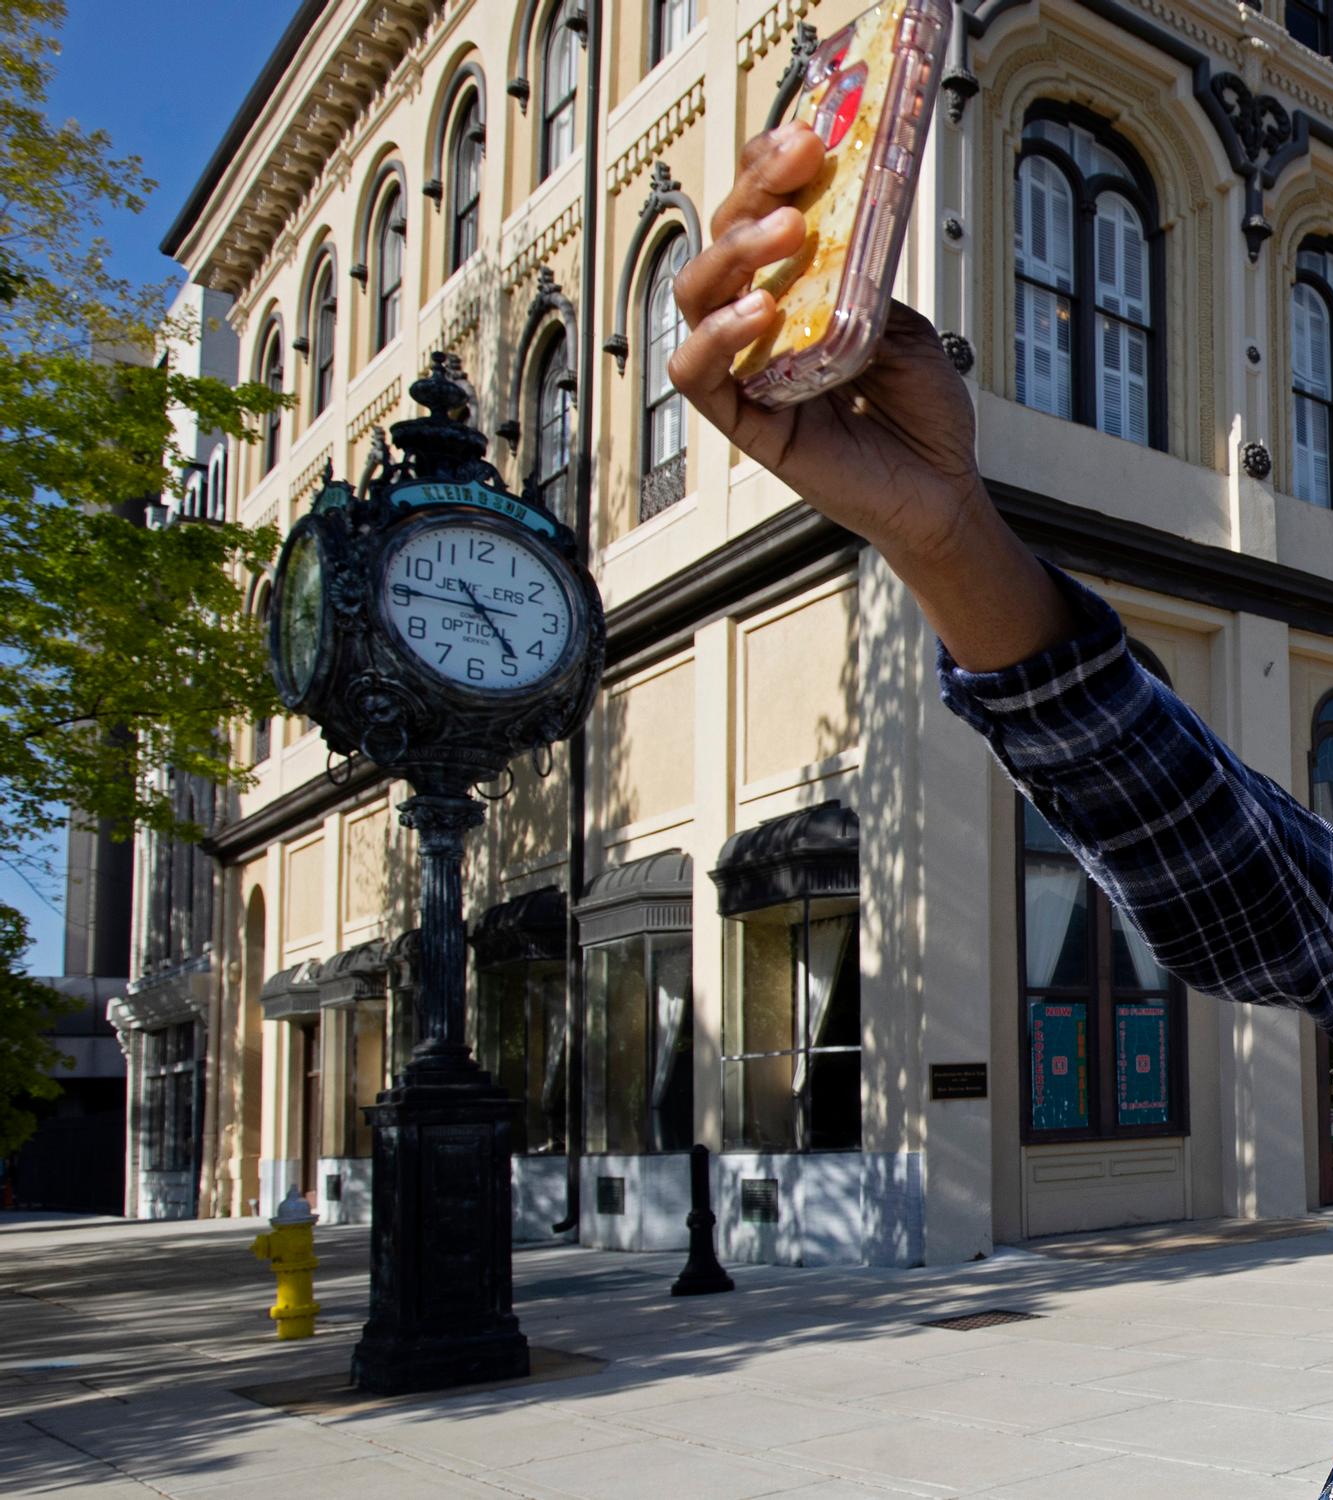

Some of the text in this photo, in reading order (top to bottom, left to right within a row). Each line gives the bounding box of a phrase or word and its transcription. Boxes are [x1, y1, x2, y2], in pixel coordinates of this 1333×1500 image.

[436, 540, 456, 566] 11
[469, 538, 496, 565] 12
[405, 556, 433, 581] 10
[510, 556, 516, 578] 1
[392, 583, 411, 607] 9
[434, 576, 526, 605] JEWEERS
[528, 581, 546, 606] 2
[408, 616, 427, 640] 8
[441, 616, 512, 643] OPTICAL
[542, 613, 559, 636] 3
[435, 642, 453, 665] 7
[526, 640, 545, 661] 4
[467, 657, 485, 680] 6
[500, 654, 518, 677] 5
[1045, 1006, 1073, 1017] NOW
[1034, 1019, 1045, 1104] PROPERTY
